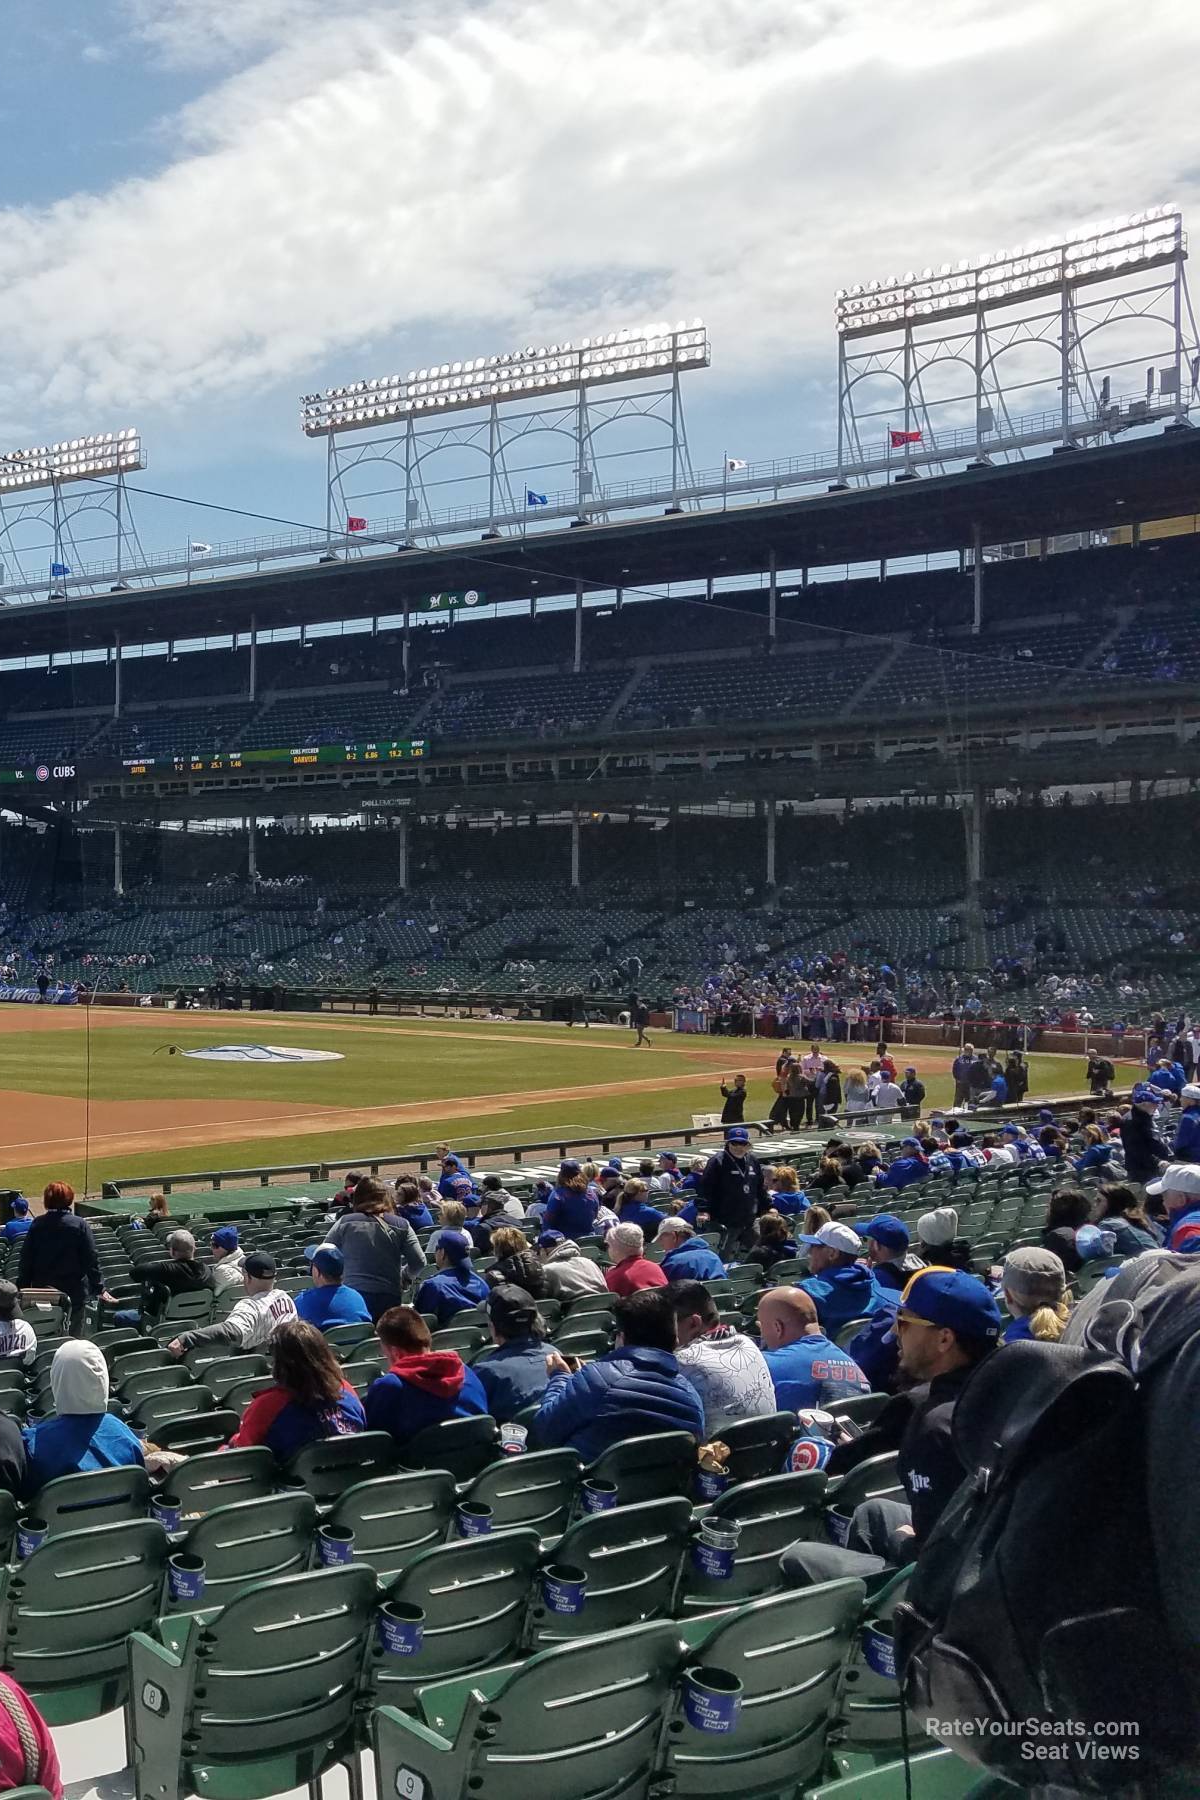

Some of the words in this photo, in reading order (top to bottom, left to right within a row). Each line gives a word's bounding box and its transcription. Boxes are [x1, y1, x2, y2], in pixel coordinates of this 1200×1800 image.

[53, 766, 75, 777] CUBS
[270, 1298, 293, 1320] RIZZO
[0, 1335, 26, 1352] RIZZO
[908, 1469, 930, 1492] Lite
[150, 1690, 155, 1704] 8
[406, 1777, 414, 1793] 9
